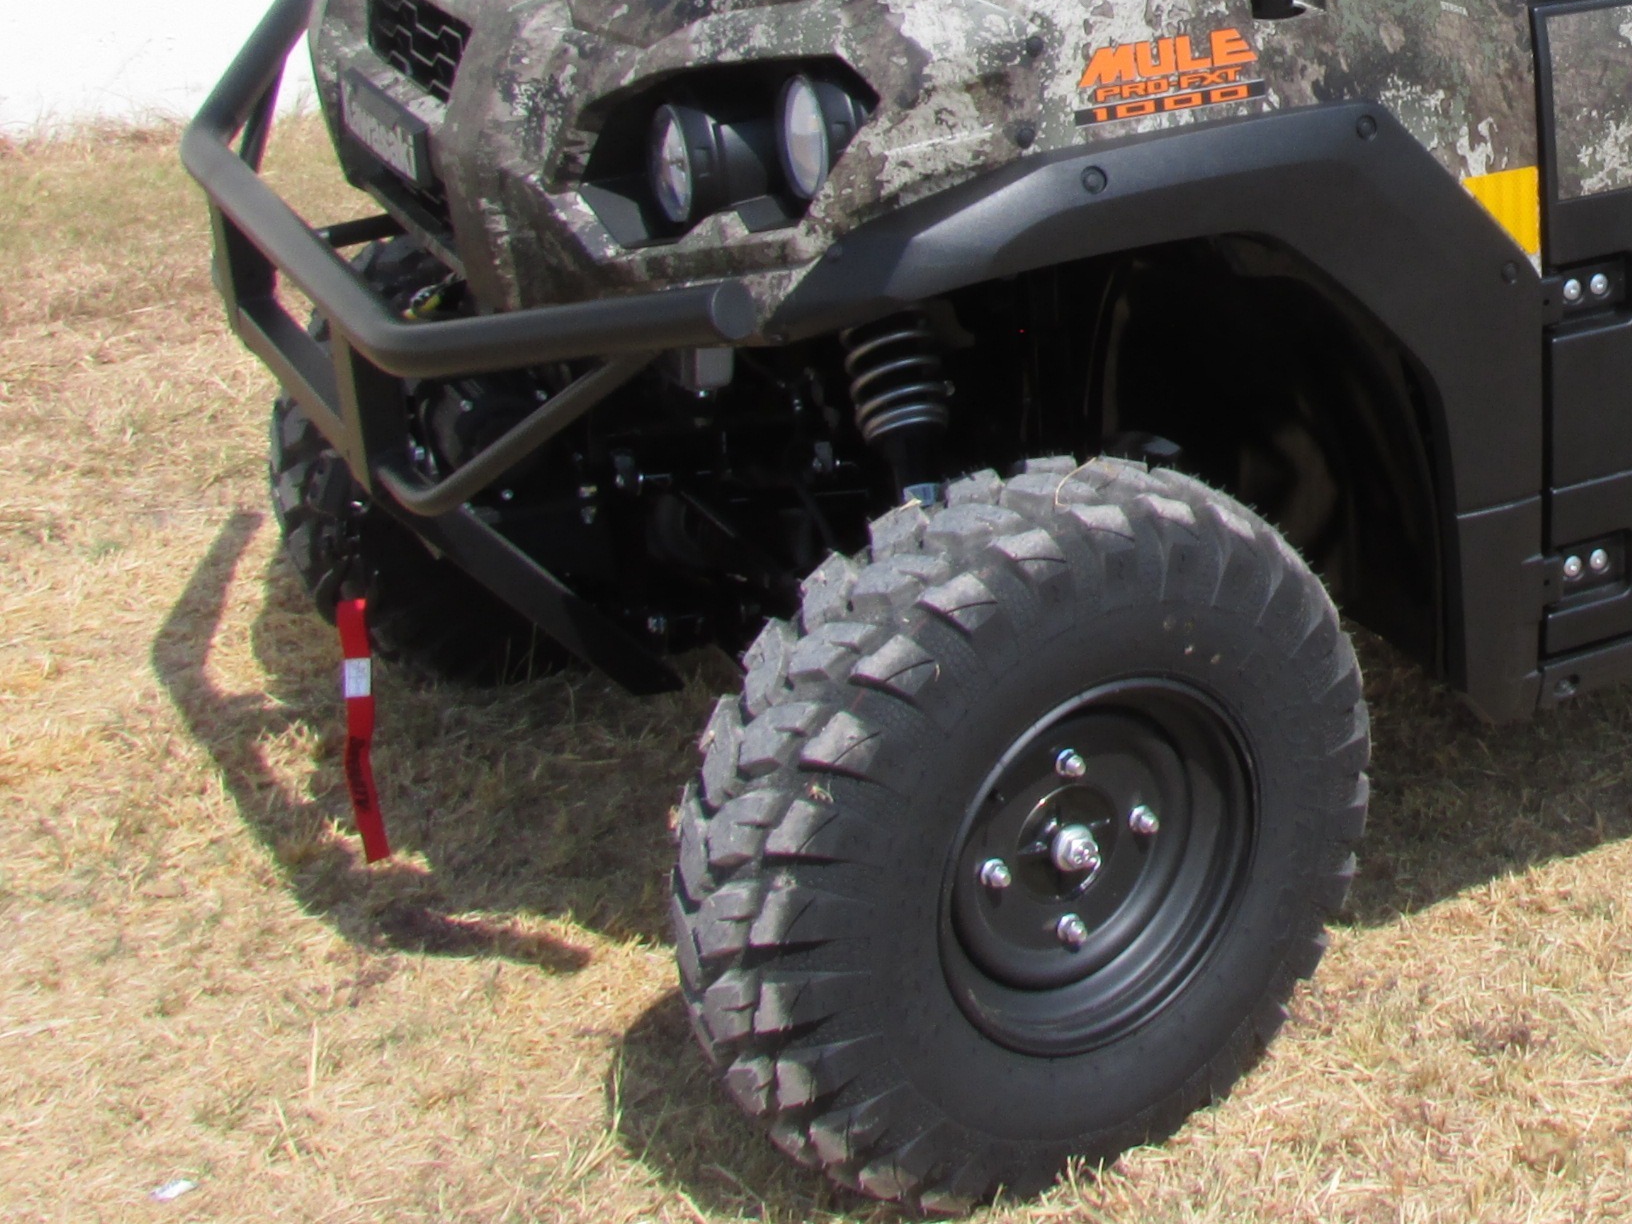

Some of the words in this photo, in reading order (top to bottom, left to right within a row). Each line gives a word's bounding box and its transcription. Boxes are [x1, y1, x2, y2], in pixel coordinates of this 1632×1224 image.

[1079, 27, 1258, 88] MULE
[1092, 84, 1249, 122] 1000
[1094, 66, 1242, 103] PRO-FXT
